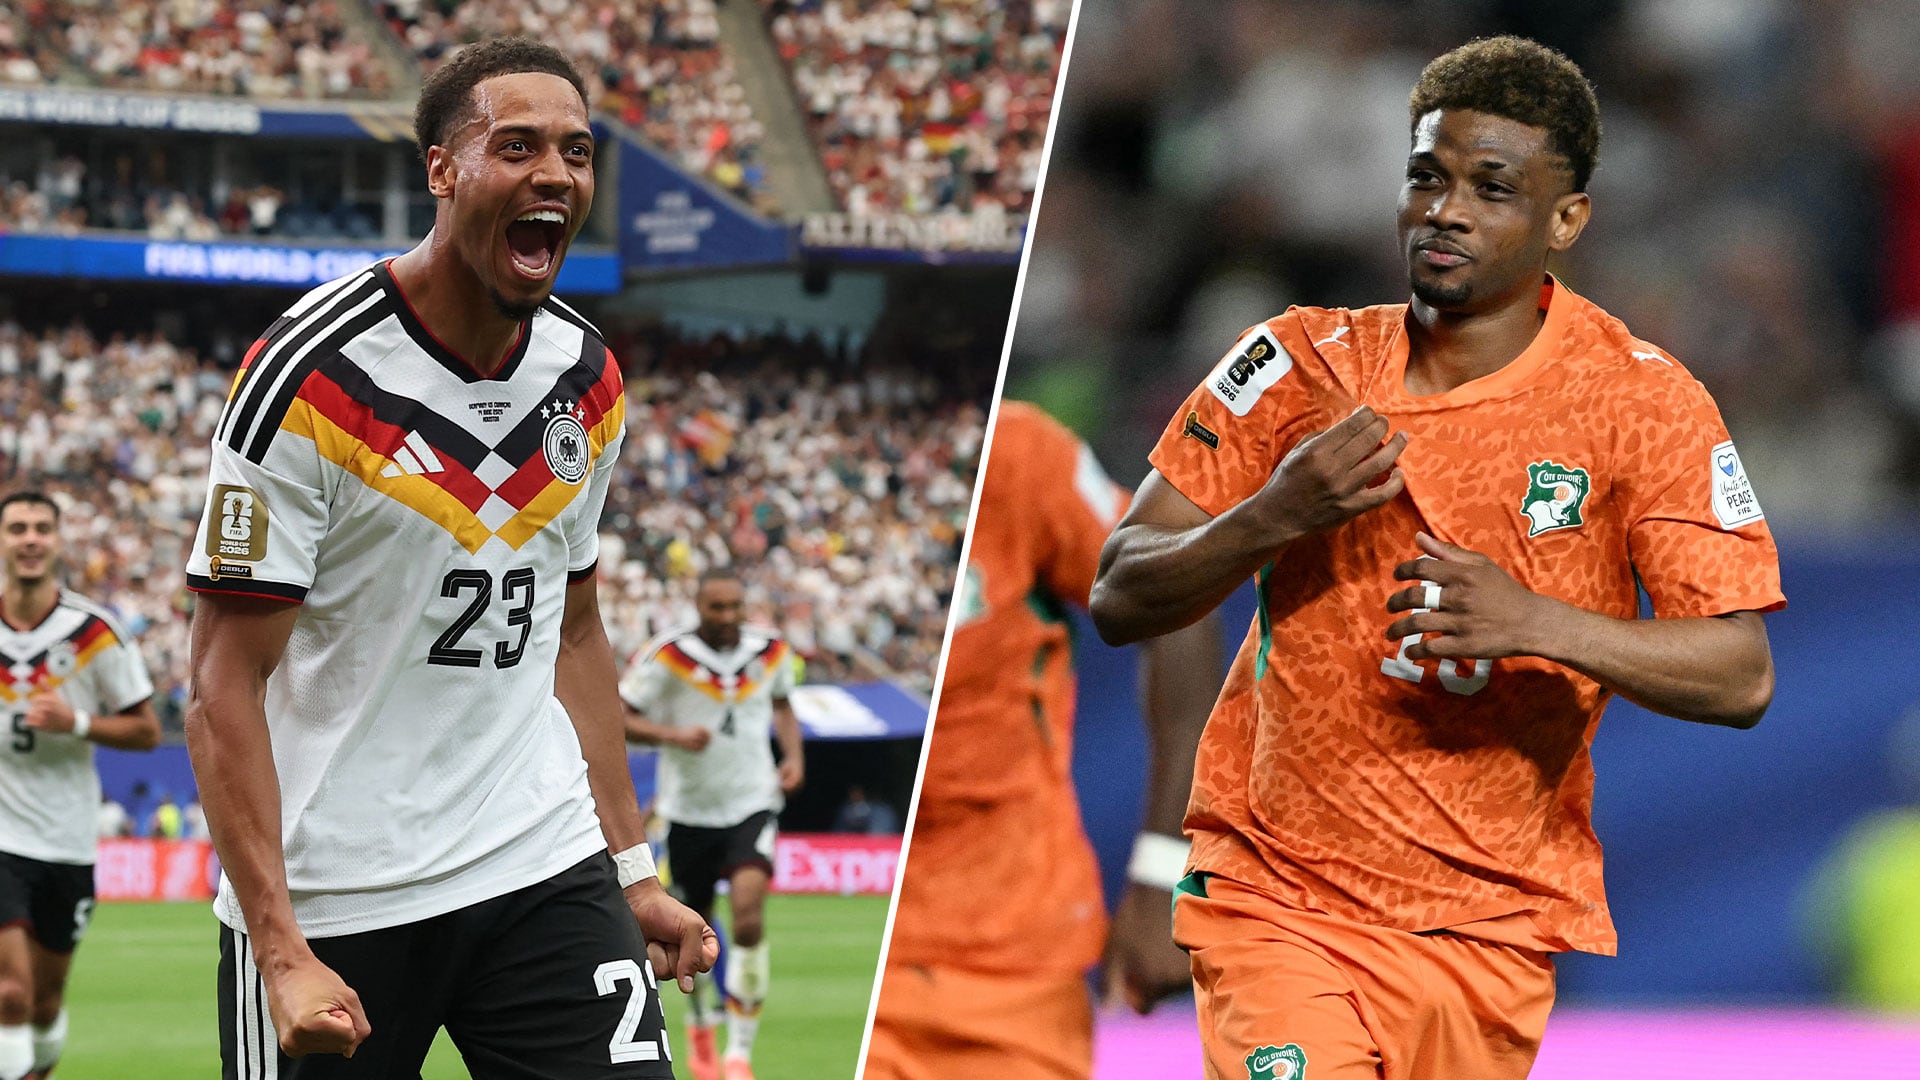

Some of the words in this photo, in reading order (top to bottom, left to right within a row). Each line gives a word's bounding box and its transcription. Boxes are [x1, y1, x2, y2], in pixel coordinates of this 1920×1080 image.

[145, 243, 208, 278] FIFA
[211, 246, 313, 284] WORLD
[219, 545, 250, 555] 2026
[220, 565, 250, 573] DEBUT
[427, 567, 535, 669] 23
[11, 713, 35, 752] 5
[720, 706, 735, 737] 4
[593, 958, 672, 1065] 2
